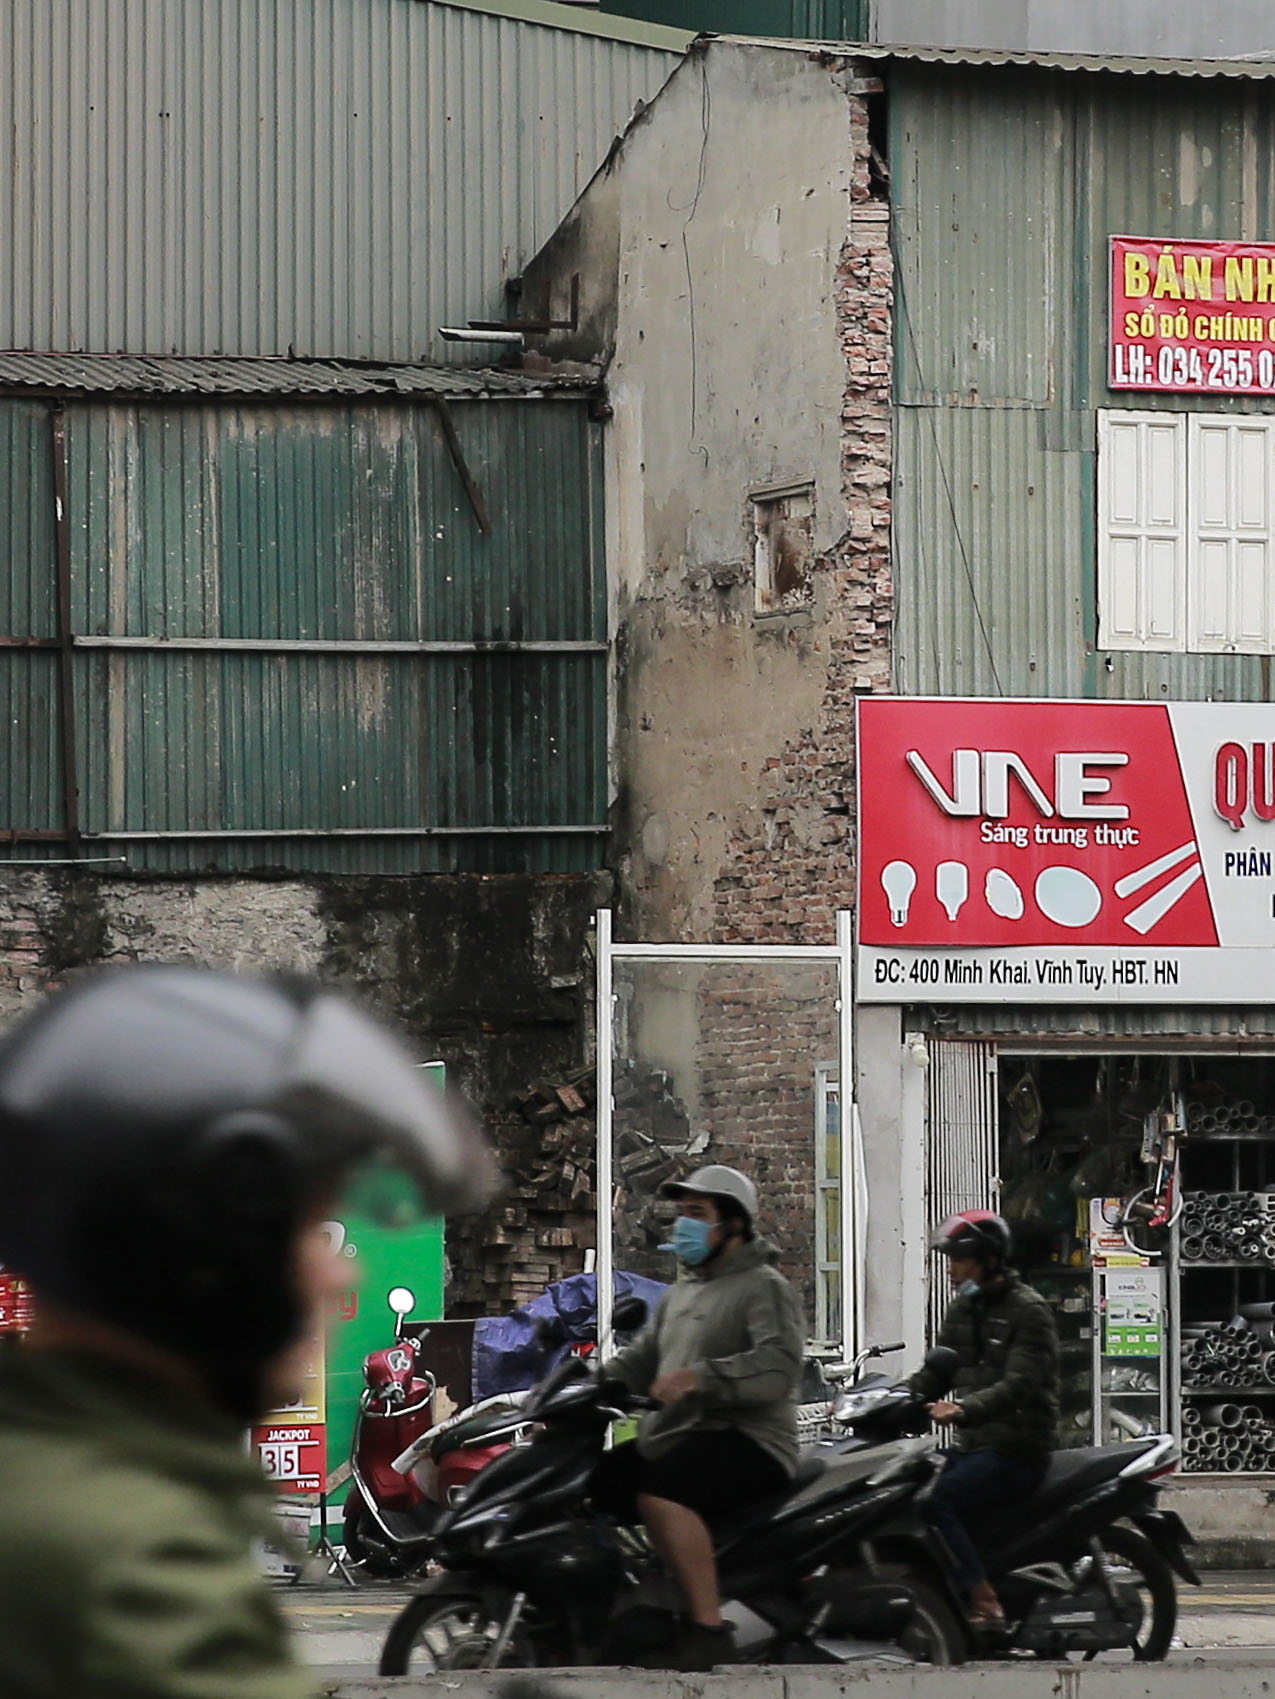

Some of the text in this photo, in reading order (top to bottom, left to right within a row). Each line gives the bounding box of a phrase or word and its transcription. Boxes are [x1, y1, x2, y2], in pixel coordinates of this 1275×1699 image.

[1124, 245, 1213, 300] BÁN
[1125, 304, 1155, 338] SỔ
[1160, 307, 1189, 340] ĐỎ
[1195, 312, 1263, 342] CHÍNH
[1114, 344, 1152, 385] LH:
[1158, 346, 1202, 386] 034
[1207, 348, 1252, 388] 255
[980, 822, 1140, 849] Sáng trung thực
[1225, 846, 1271, 877] PHÂN
[875, 959, 905, 984] ĐC:
[909, 959, 939, 984] 400
[945, 959, 982, 984] Minh
[1112, 960, 1149, 984] HBT.
[1154, 960, 1178, 984] HN
[267, 1429, 311, 1441] JACKPOT
